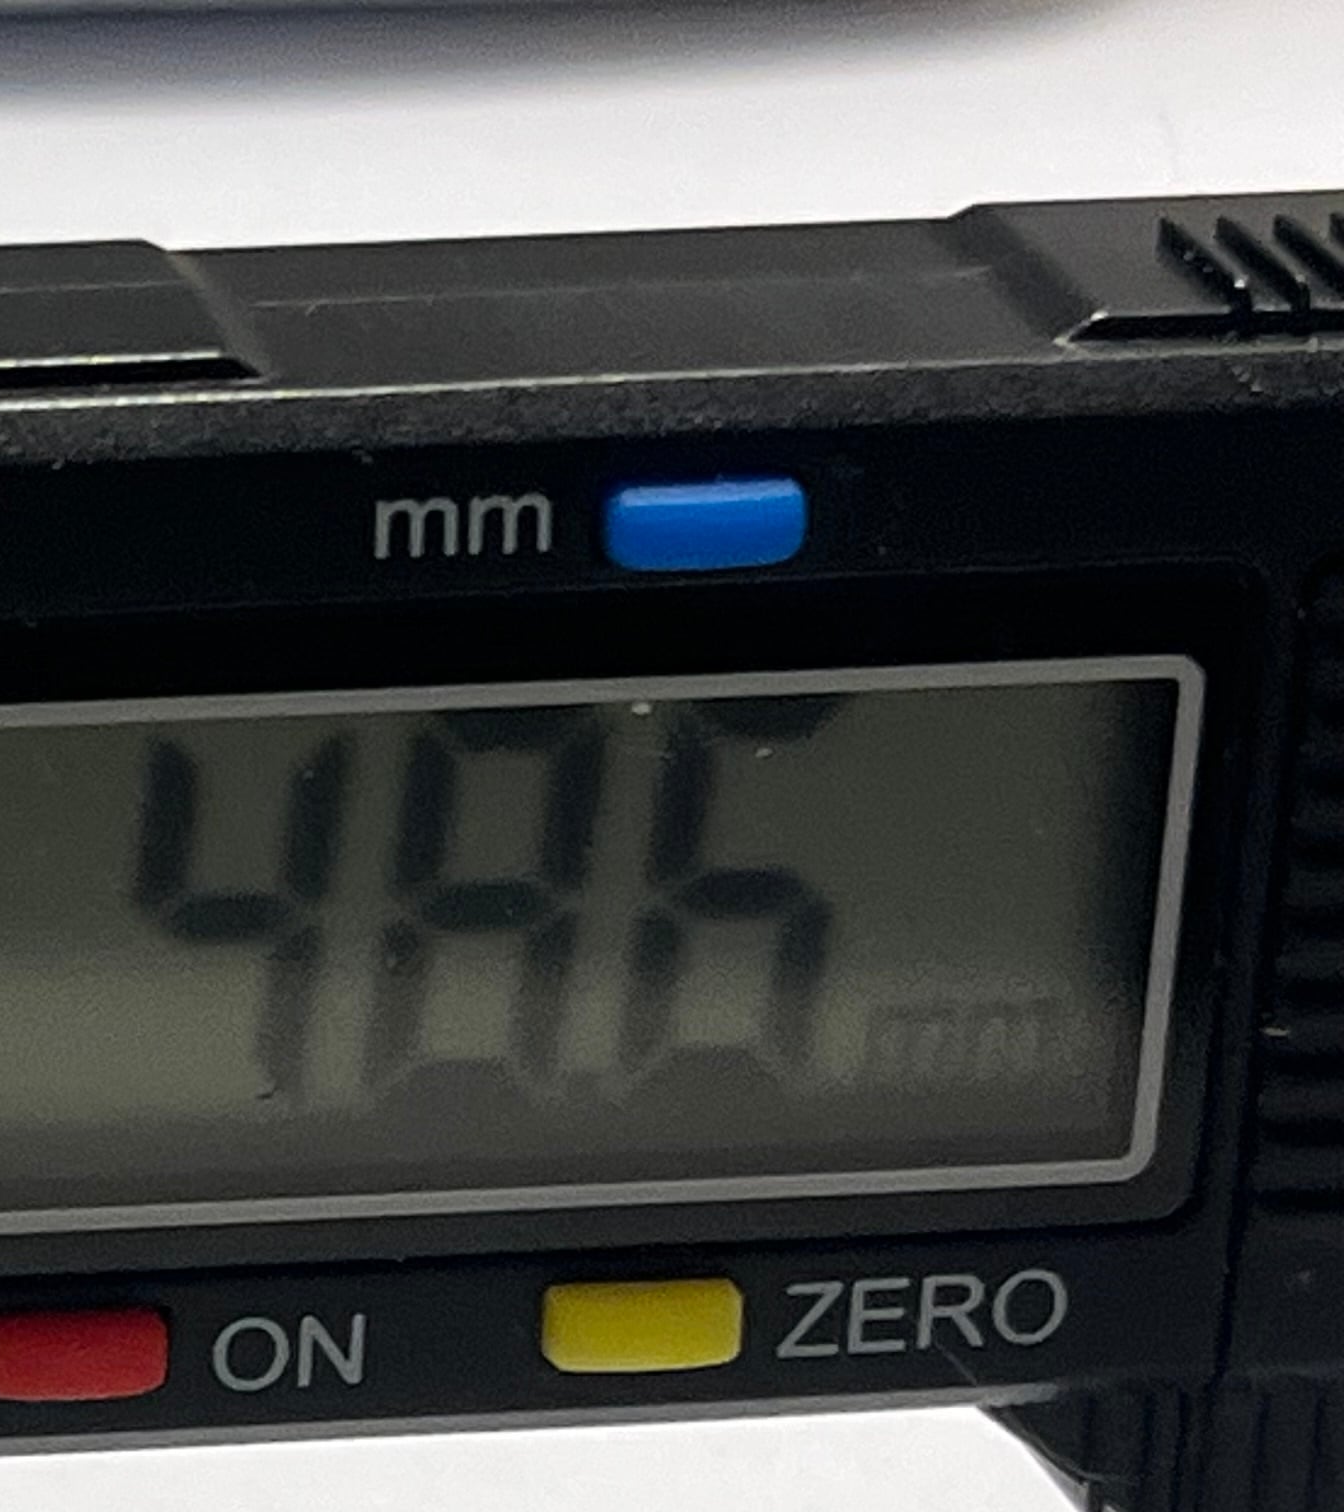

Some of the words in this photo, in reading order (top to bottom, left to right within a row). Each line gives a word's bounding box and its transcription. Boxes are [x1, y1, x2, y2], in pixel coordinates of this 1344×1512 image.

[374, 493, 552, 559] mm
[213, 1313, 365, 1391] ON
[776, 1268, 1068, 1358] ZERO
